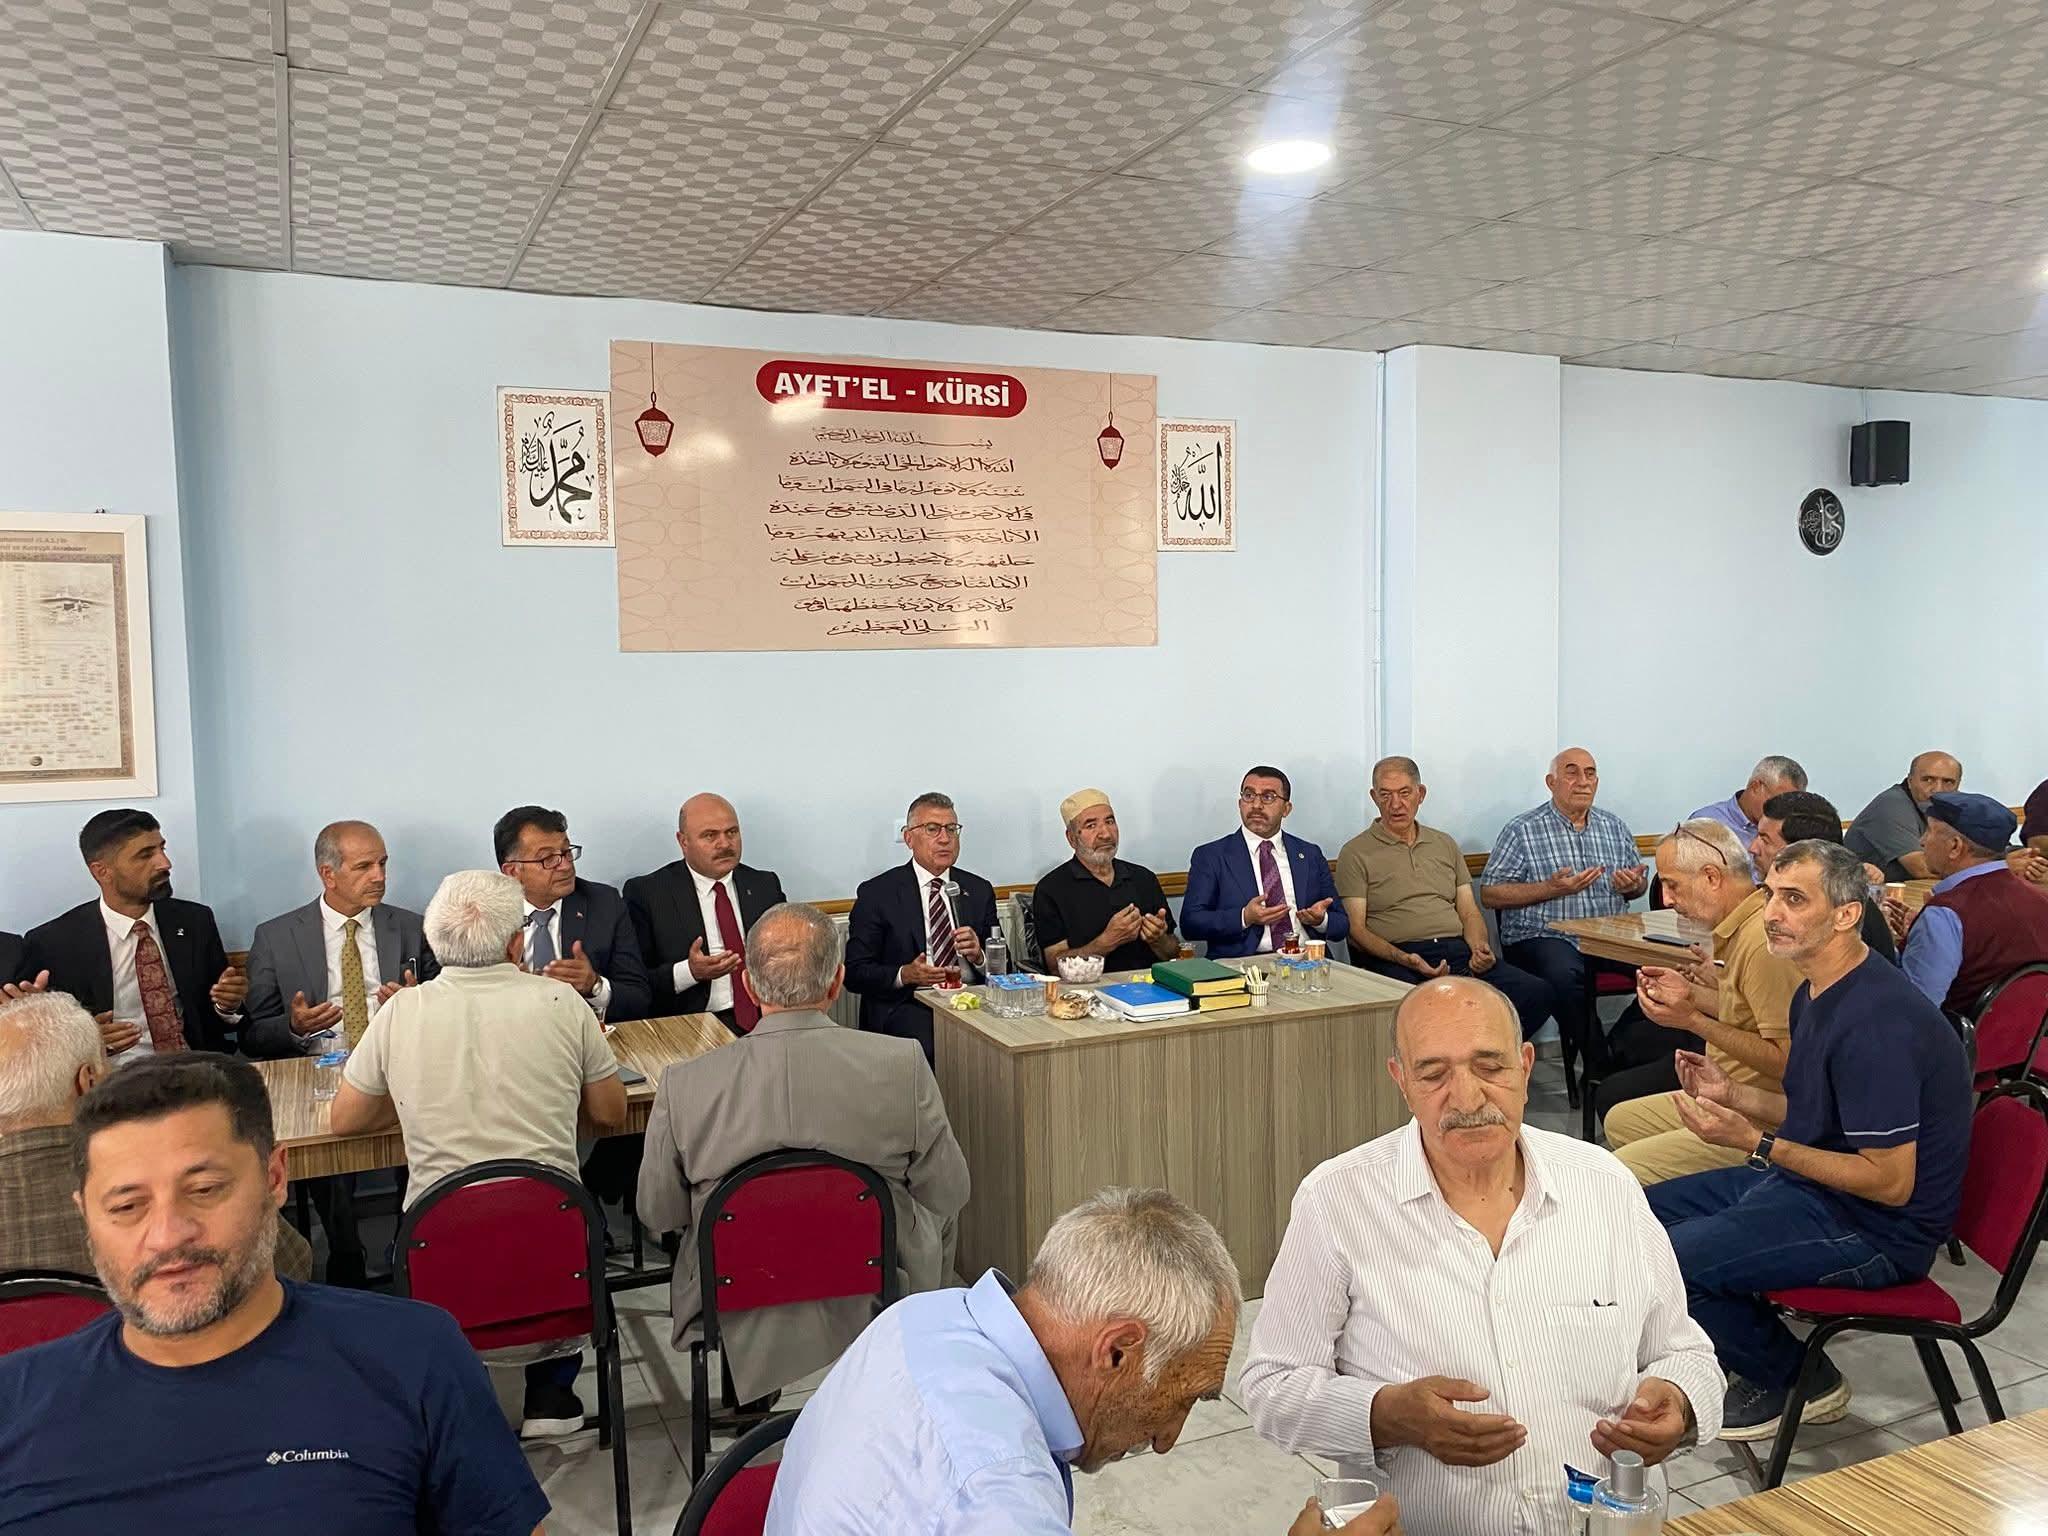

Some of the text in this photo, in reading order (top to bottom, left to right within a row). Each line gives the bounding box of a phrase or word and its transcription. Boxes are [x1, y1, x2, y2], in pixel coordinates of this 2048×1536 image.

[774, 372, 896, 400] AYET'EL
[926, 377, 1010, 407] KÜRSİ
[282, 1448, 350, 1463] Columbia
